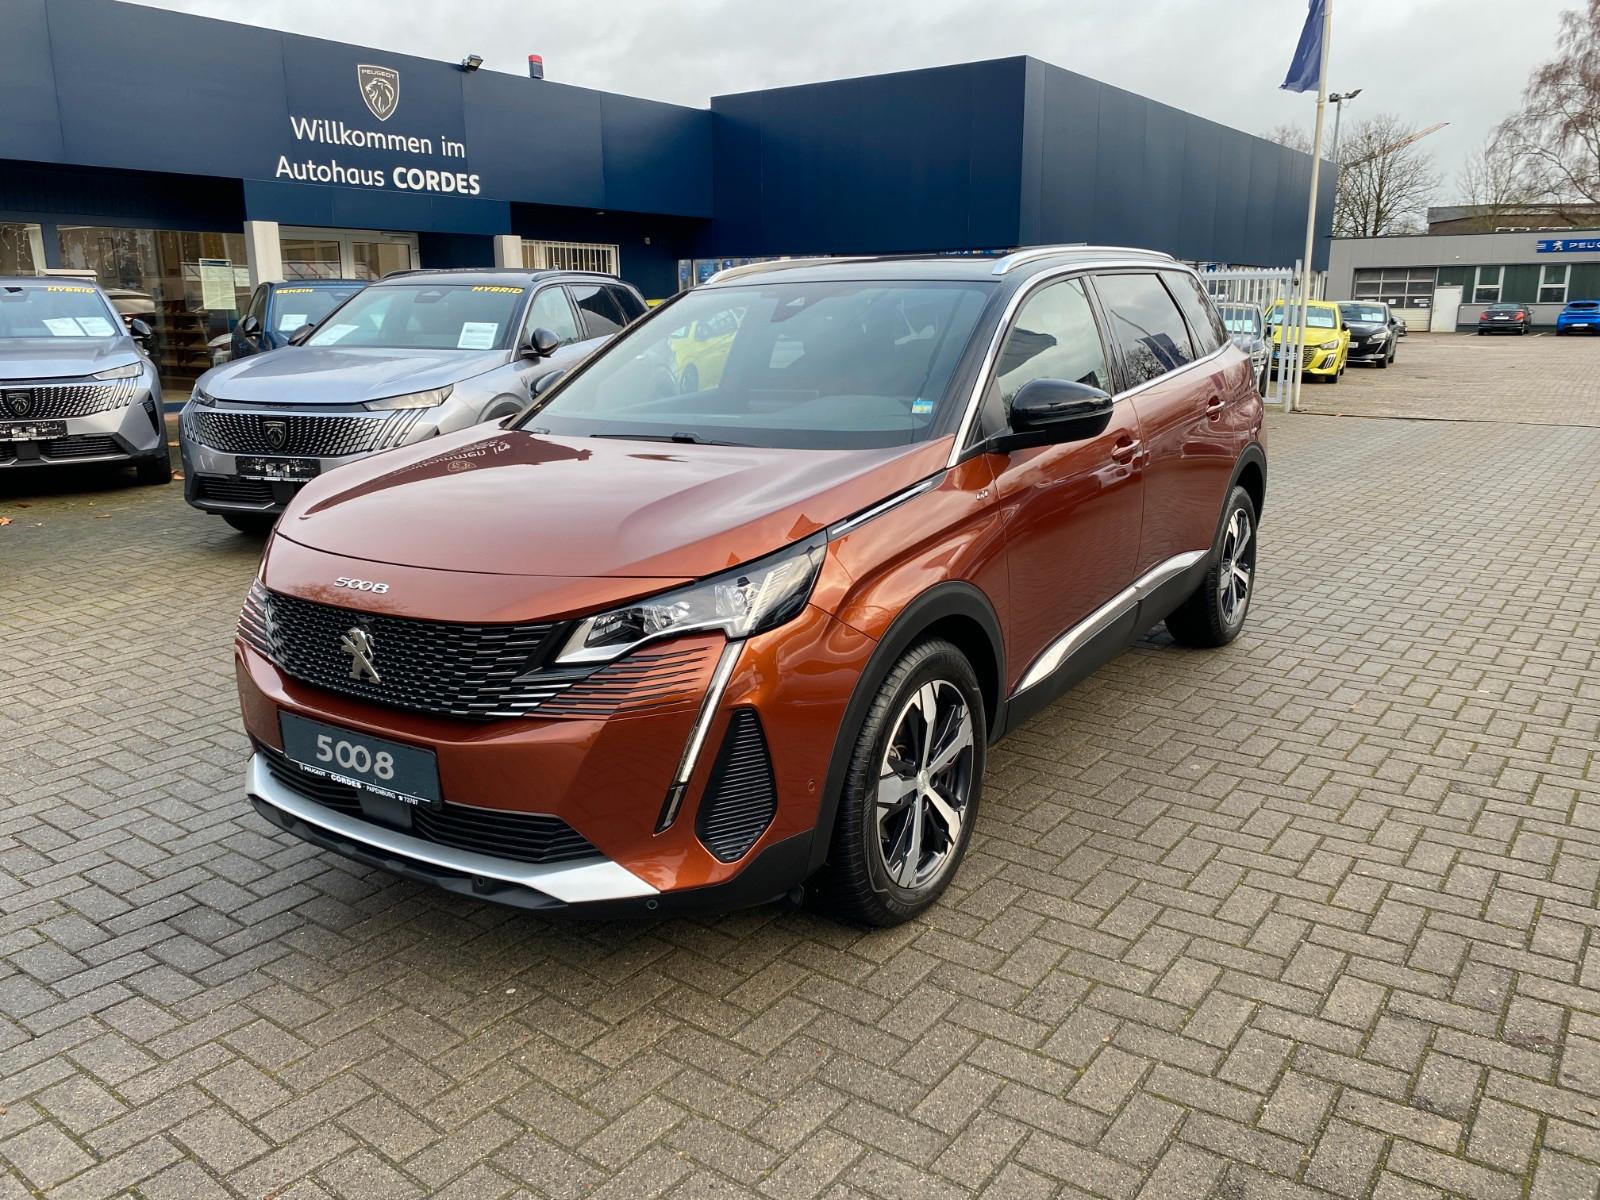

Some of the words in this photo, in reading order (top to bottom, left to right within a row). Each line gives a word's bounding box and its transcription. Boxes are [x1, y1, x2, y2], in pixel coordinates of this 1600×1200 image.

[361, 69, 395, 79] PEUGEOT
[290, 116, 432, 154] Willkommen
[441, 136, 465, 158] im
[276, 155, 385, 187] Autohaus
[392, 166, 480, 195] CORDES
[47, 286, 96, 294] HYBRID
[472, 285, 524, 295] HYBRID
[334, 576, 389, 594] 5008
[316, 734, 395, 780] 5008
[330, 773, 362, 789] CORDES
